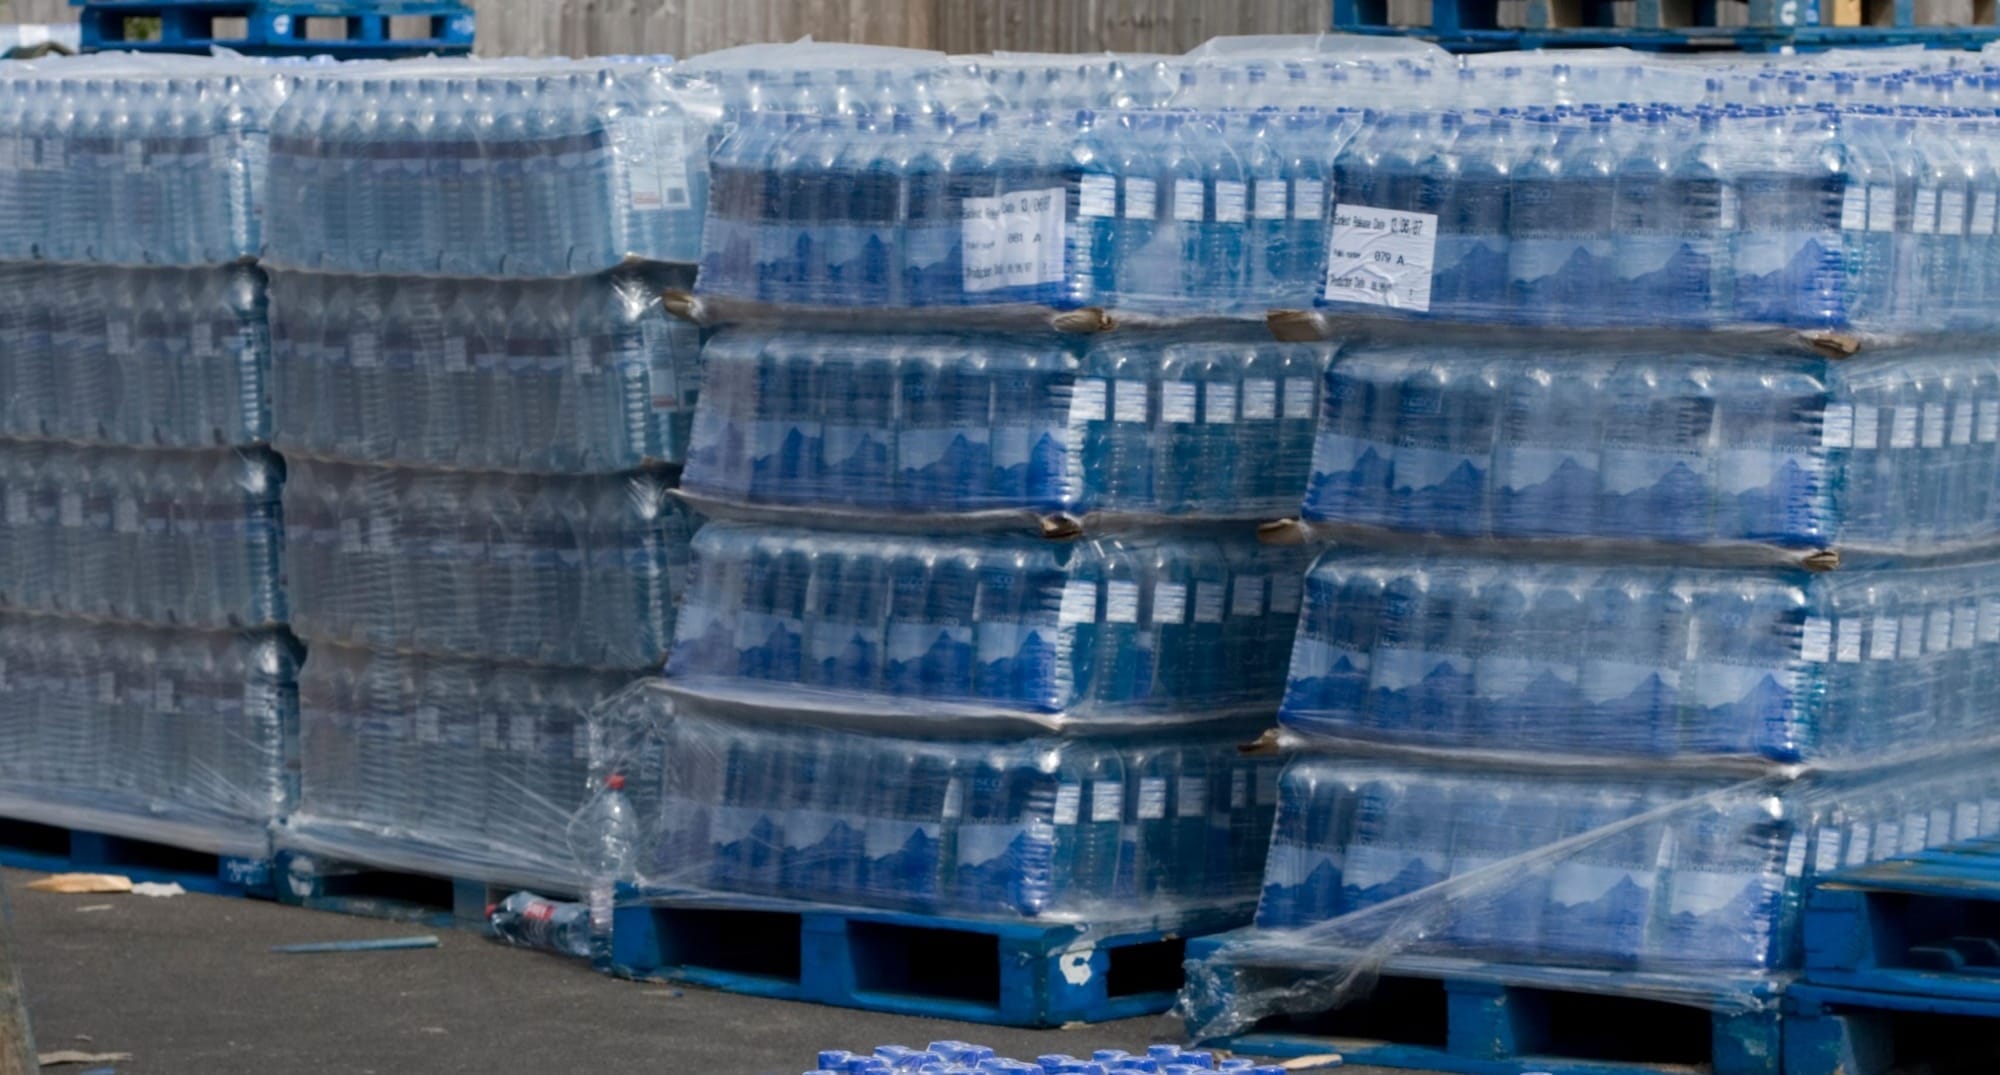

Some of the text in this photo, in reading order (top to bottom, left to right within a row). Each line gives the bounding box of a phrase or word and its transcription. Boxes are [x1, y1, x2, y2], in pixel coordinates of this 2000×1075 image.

[1033, 233, 1042, 242] A
[1374, 251, 1391, 263] 079
[1396, 255, 1405, 265] A
